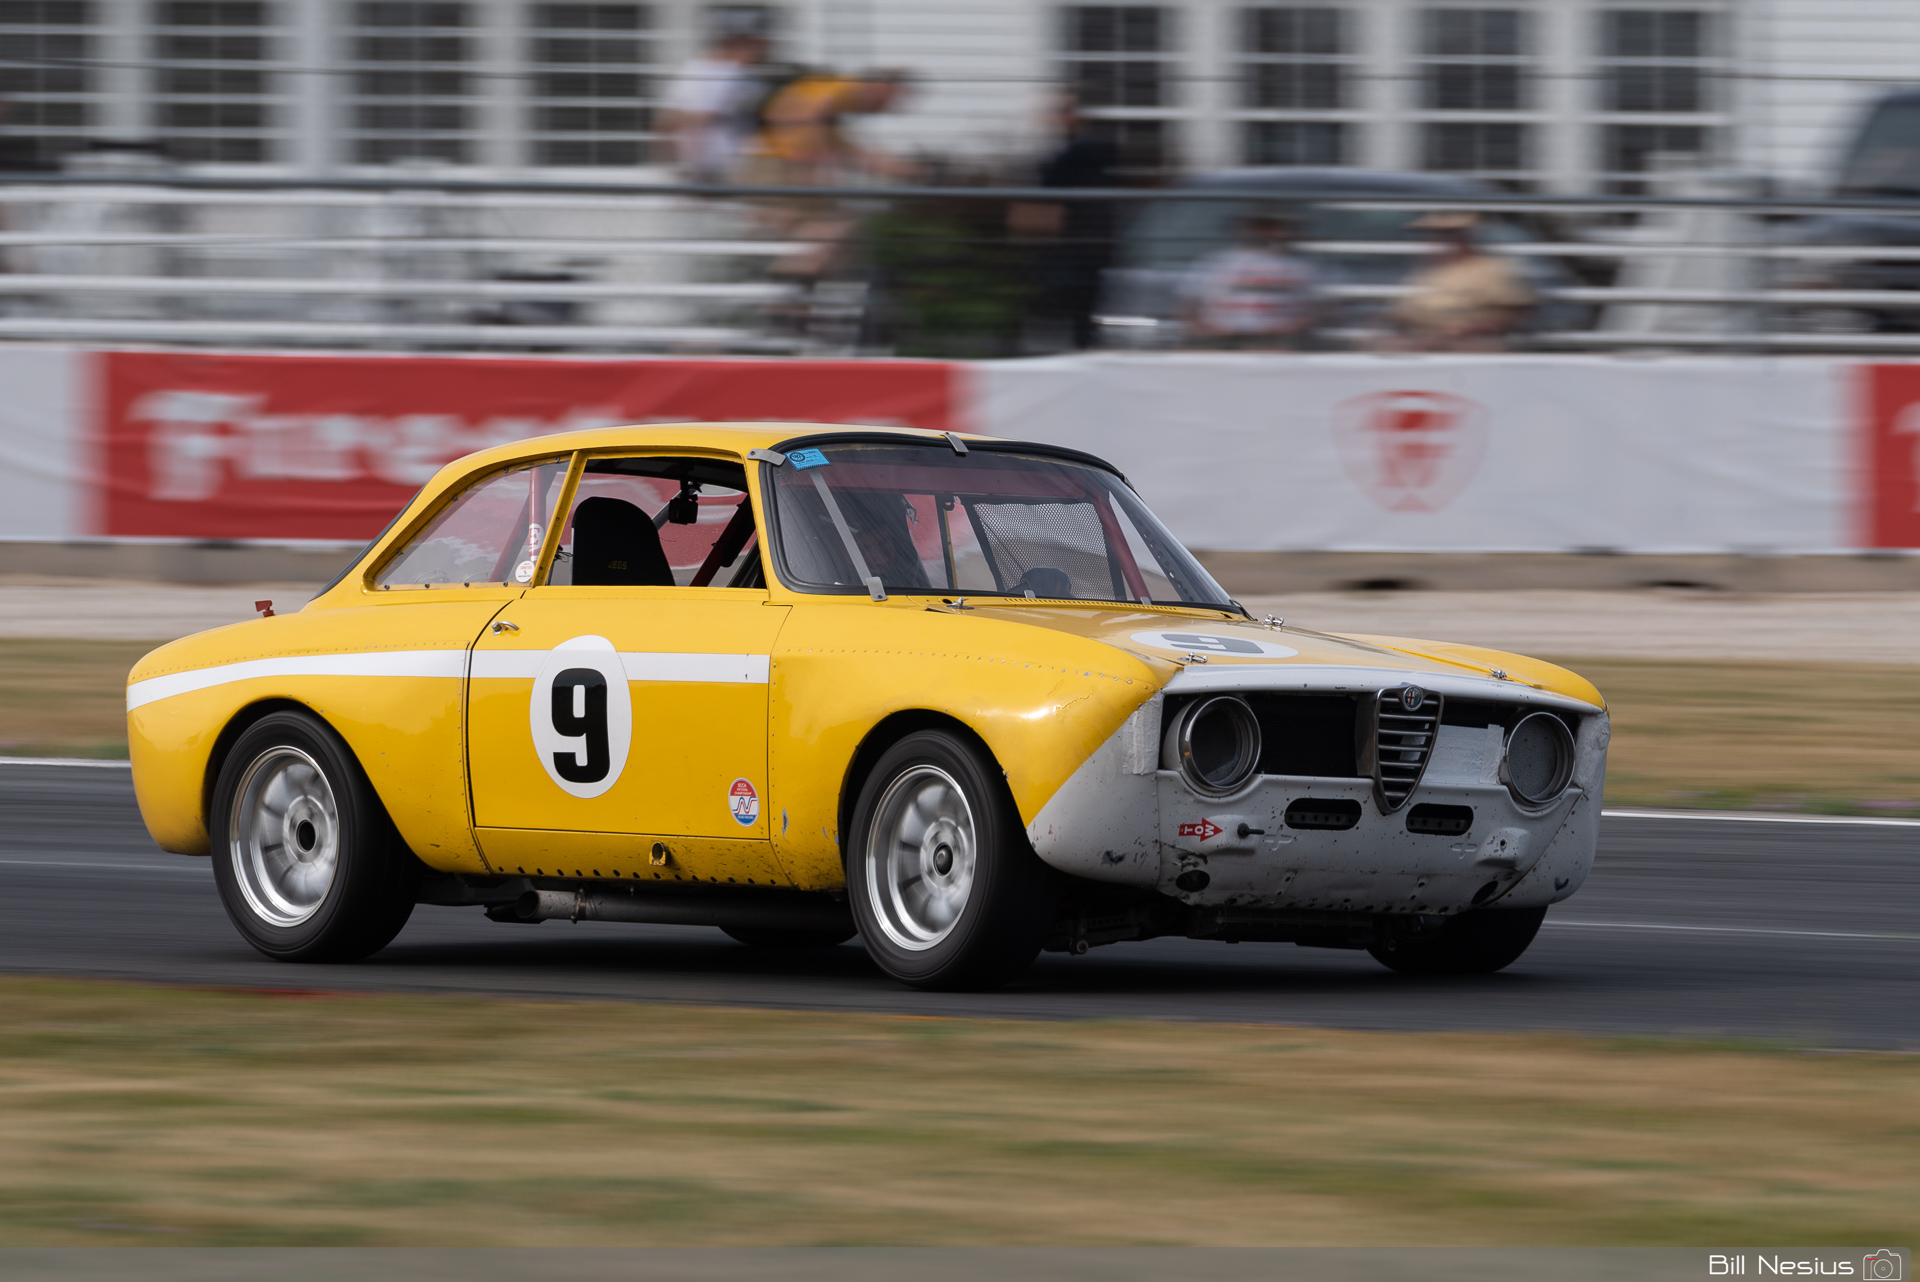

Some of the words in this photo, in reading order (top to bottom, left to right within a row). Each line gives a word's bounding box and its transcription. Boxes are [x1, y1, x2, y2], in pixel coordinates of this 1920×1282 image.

[608, 560, 628, 570] JEGS
[1161, 633, 1264, 654] 9
[551, 667, 610, 783] 9
[1183, 824, 1215, 837] TOW
